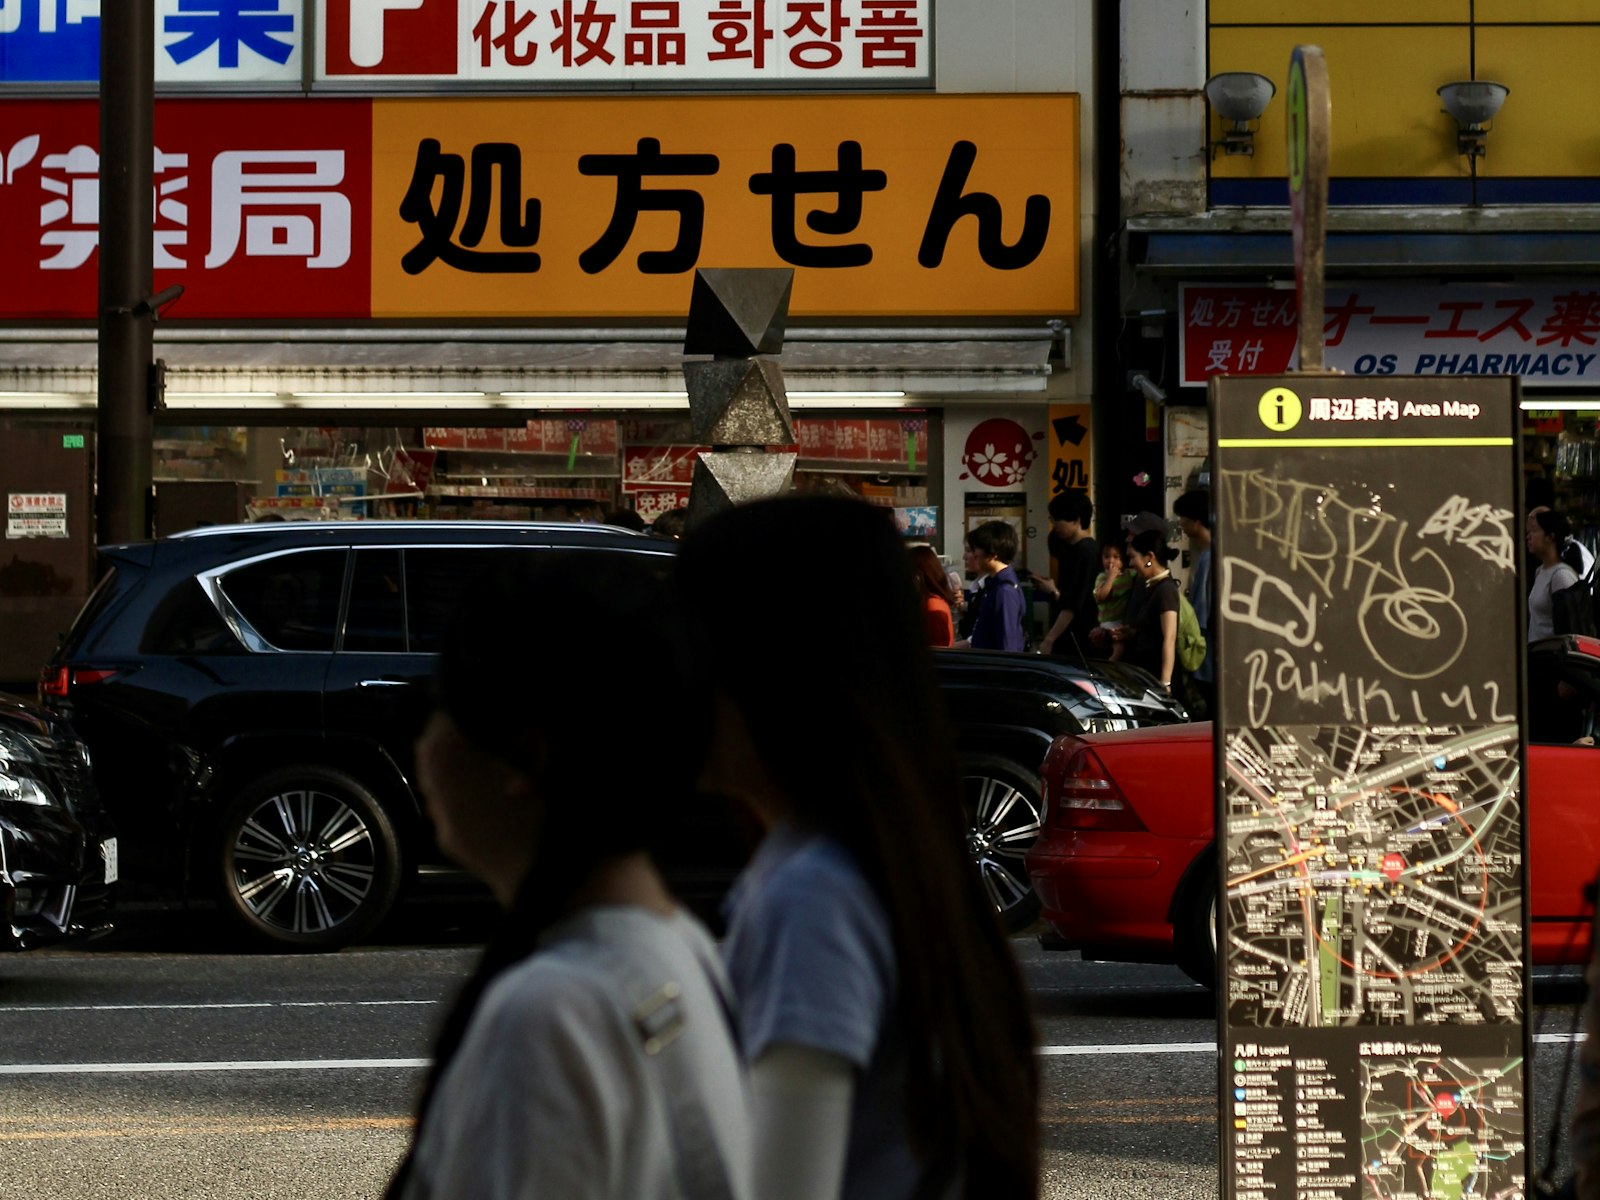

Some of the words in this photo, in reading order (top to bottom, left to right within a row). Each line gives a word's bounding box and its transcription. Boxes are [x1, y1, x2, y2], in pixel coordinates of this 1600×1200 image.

[472, 0, 686, 67] 化妆品
[707, 0, 923, 69] 화장품
[399, 136, 1051, 275] 処方せん
[1188, 295, 1297, 328] 処方せん
[1204, 339, 1265, 371] 受付
[1354, 354, 1397, 375] OS
[1414, 354, 1597, 376] PHARMACY
[1308, 397, 1400, 421] 周辺案内
[1402, 401, 1441, 417] Area
[1443, 401, 1480, 419] Map
[1259, 1045, 1290, 1057] Legend
[1406, 1044, 1422, 1055] Key
[1423, 1043, 1442, 1055] Map
